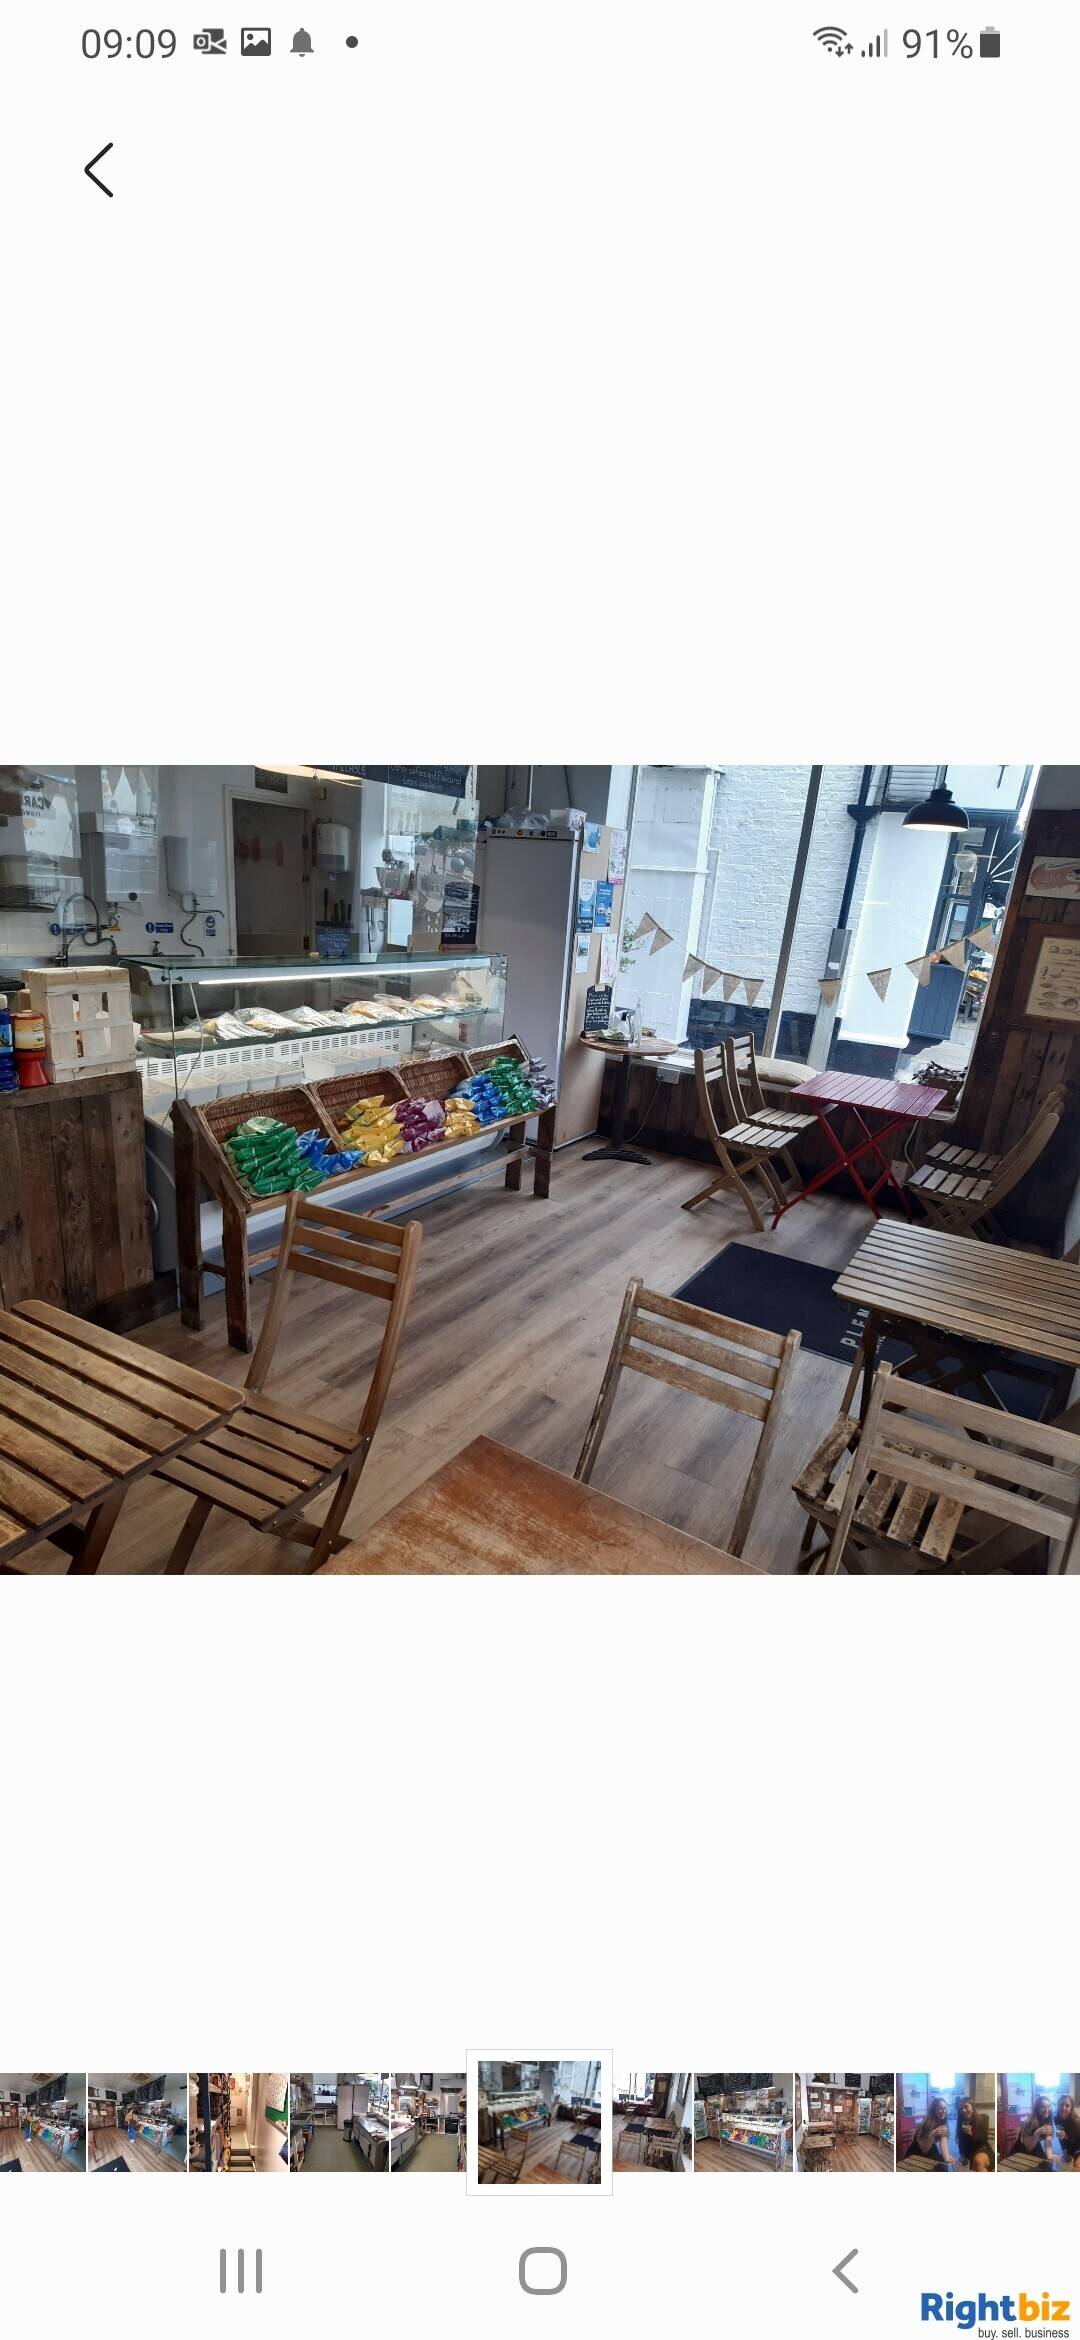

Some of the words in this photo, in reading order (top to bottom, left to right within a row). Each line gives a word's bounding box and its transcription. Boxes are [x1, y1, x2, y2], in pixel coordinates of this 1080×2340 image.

[82, 29, 176, 58] 09:09
[903, 27, 973, 58] 91%
[839, 1308, 871, 1349] PLEN
